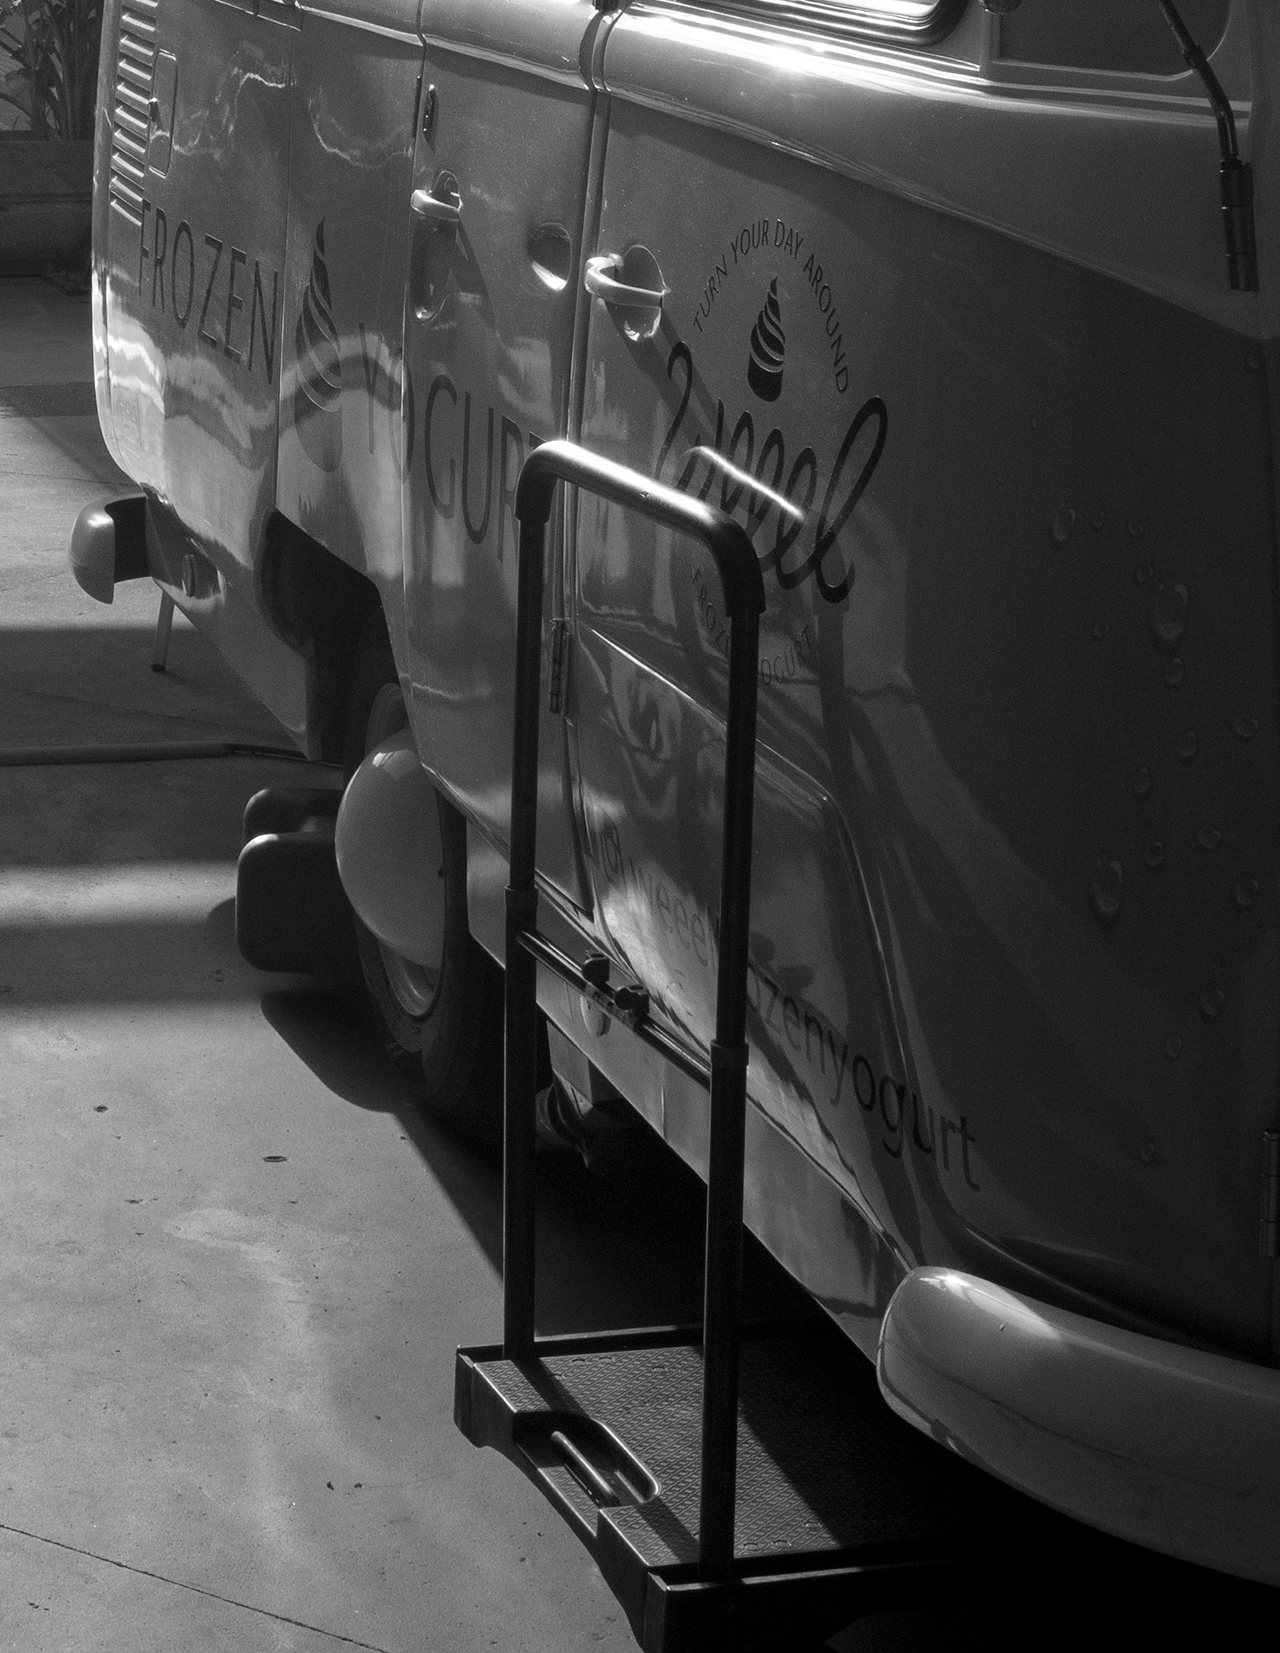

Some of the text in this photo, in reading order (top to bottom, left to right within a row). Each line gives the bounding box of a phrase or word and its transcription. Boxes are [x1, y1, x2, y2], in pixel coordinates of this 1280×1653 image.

[140, 198, 544, 562] FROZEN YOGUR
[693, 219, 850, 394] TURN YOUR DAY AROUND
